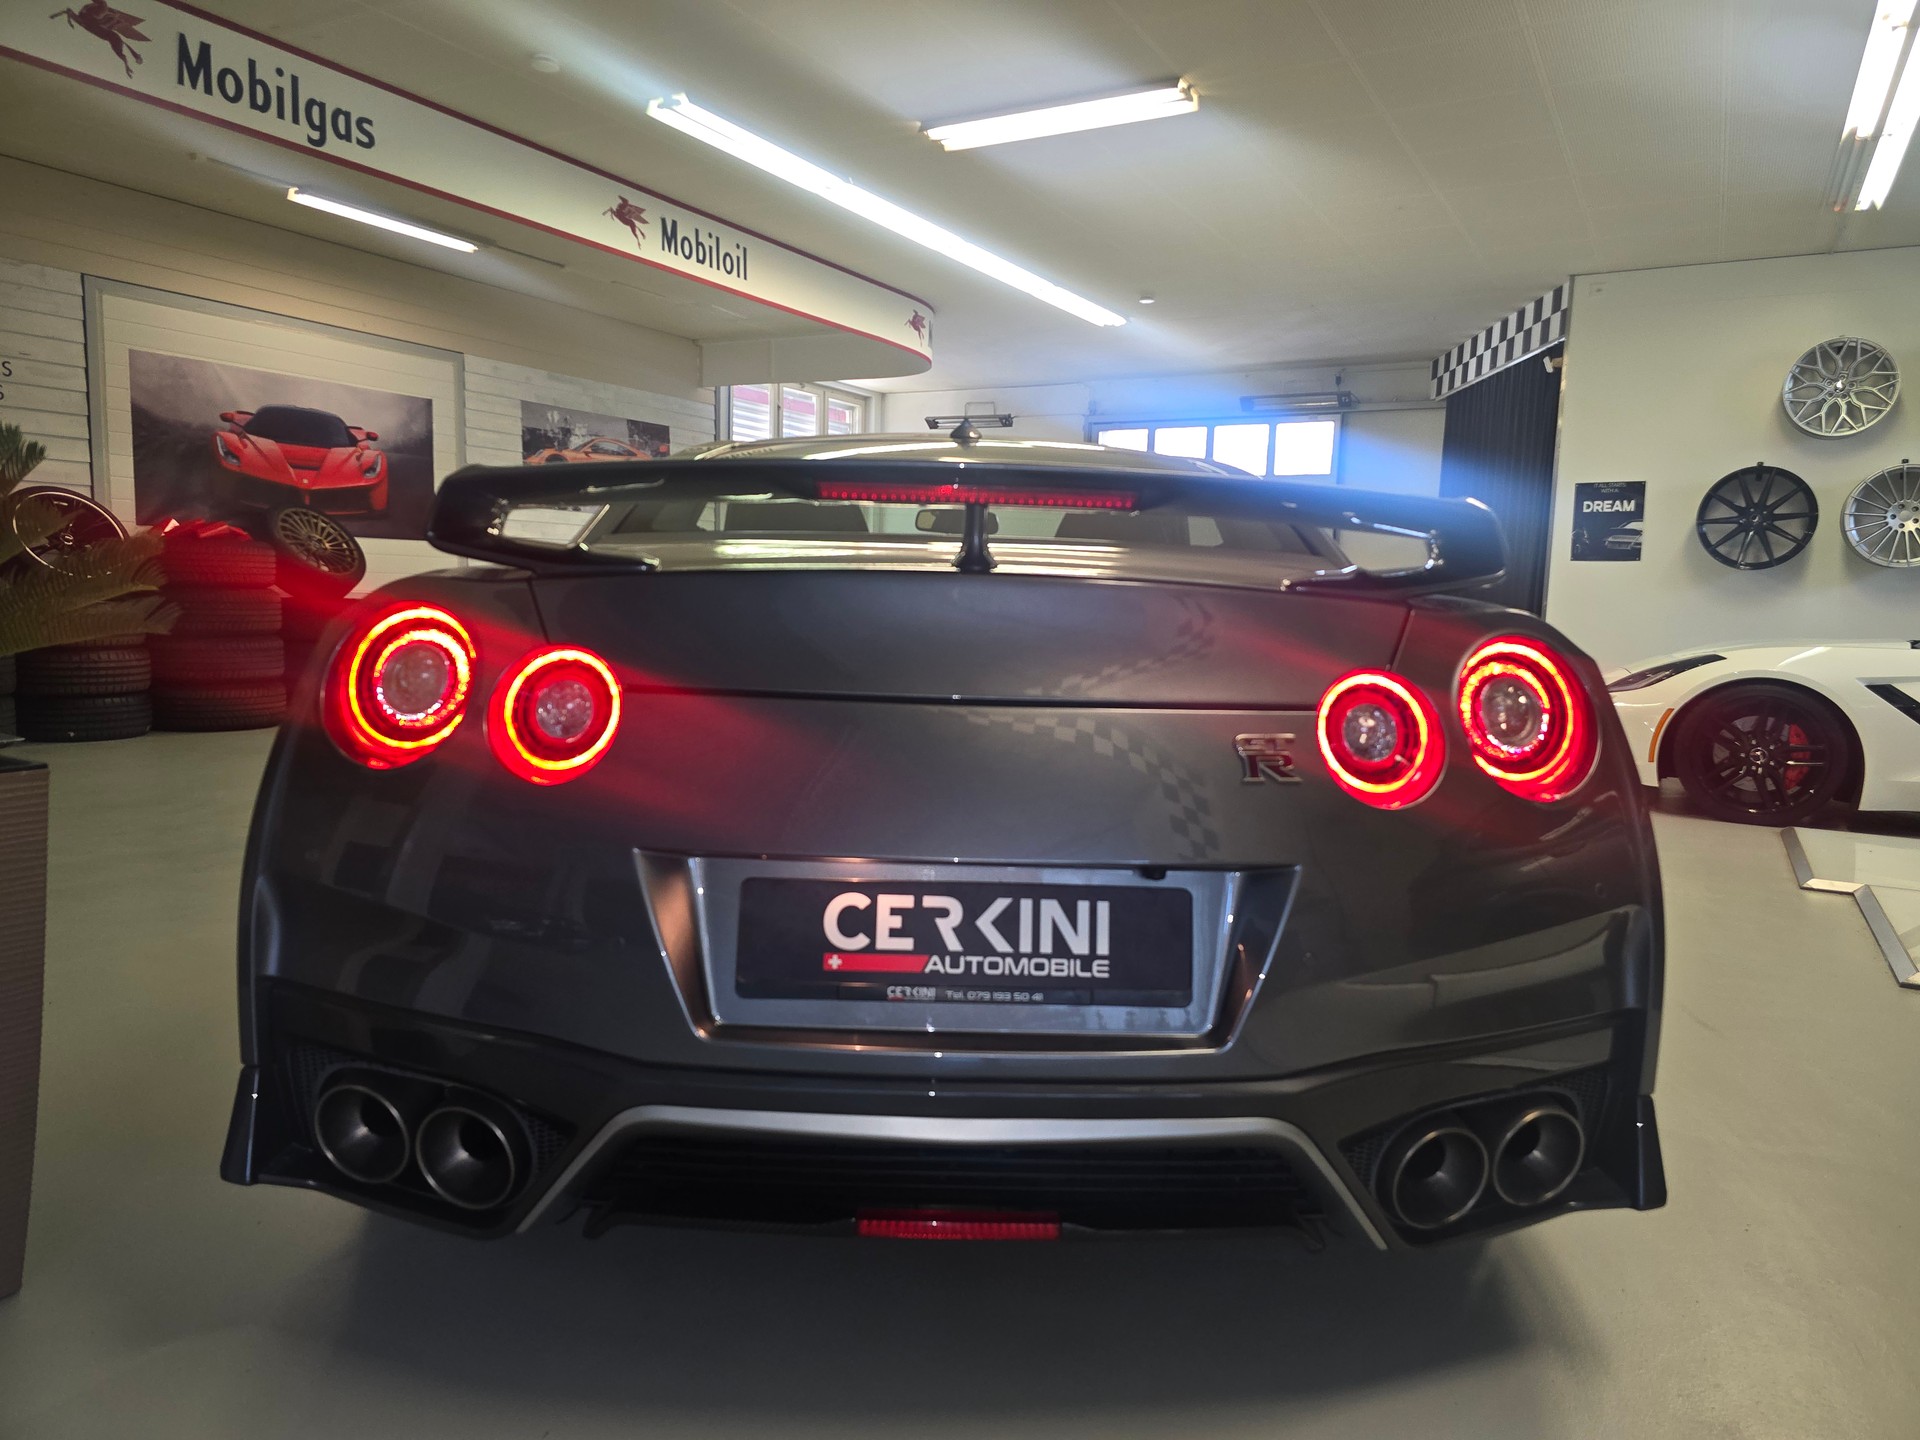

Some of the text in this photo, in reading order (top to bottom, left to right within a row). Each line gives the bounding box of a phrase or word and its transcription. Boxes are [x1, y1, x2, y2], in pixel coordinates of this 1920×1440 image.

[177, 32, 376, 149] Mobilgas
[660, 217, 748, 281] Mobiloil
[1583, 500, 1636, 513] DREAM
[822, 891, 1111, 957] CERKINI
[924, 954, 1111, 979] AUTOMOBILE
